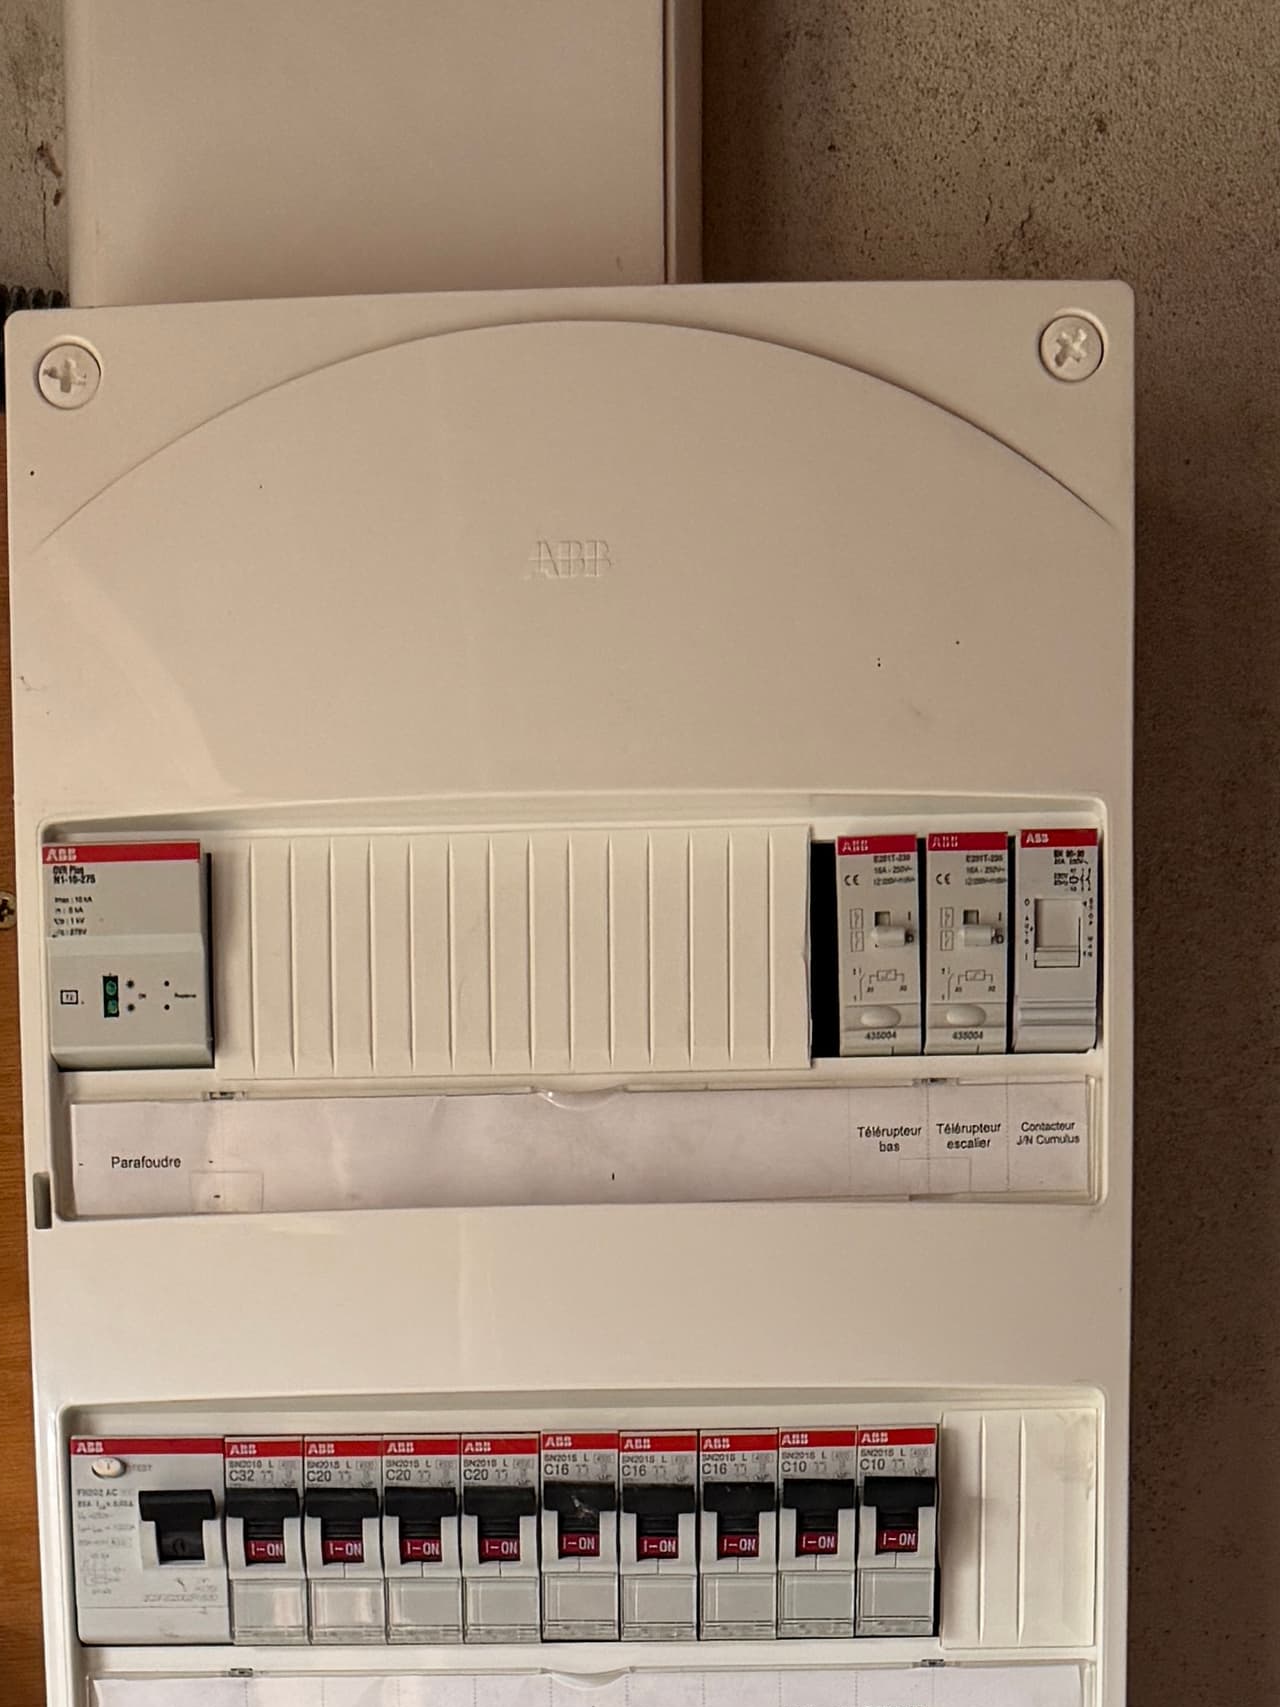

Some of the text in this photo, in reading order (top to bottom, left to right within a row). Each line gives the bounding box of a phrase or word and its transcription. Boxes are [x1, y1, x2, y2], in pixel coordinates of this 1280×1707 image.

[1025, 833, 1049, 845] ABB
[46, 848, 77, 861] ABB
[857, 1125, 922, 1140] Télérupteur
[936, 1122, 1002, 1138] Télérupteur
[1021, 1121, 1076, 1133] Contacteur
[946, 1137, 991, 1150] escalier
[1035, 1134, 1080, 1146] Cumulus
[878, 1142, 900, 1153] bas
[111, 1155, 181, 1169] Parafoudre
[77, 1442, 104, 1453] ABB
[544, 1464, 569, 1475] C16
[622, 1465, 647, 1477] C16
[781, 1461, 807, 1473] C10
[229, 1470, 255, 1481] C32
[307, 1470, 332, 1482] C20
[385, 1469, 411, 1481] C20
